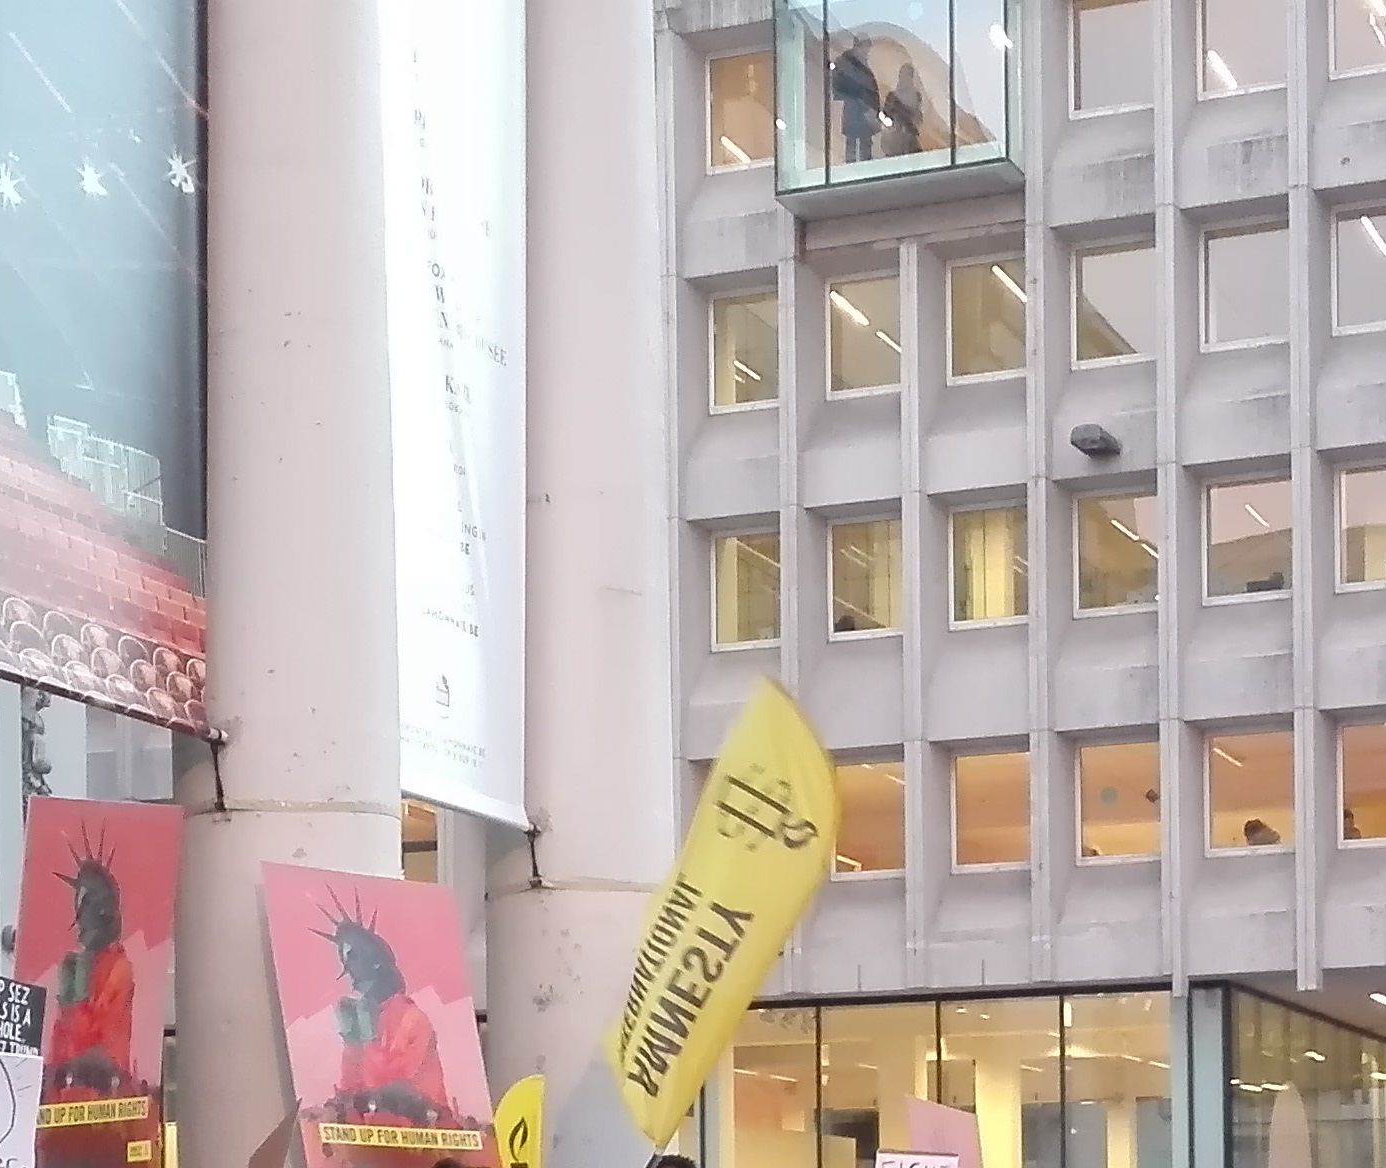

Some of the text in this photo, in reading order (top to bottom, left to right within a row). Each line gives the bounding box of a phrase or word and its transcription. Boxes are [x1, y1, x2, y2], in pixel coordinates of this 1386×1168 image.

[8, 982, 30, 1005] SEZ
[11, 1003, 21, 1023] IS
[22, 1008, 31, 1027] A
[68, 1105, 85, 1122] FOR
[87, 1102, 116, 1120] HUMAN
[118, 1099, 146, 1118] RIGHTS
[323, 1126, 479, 1147] STAND UP FOR HUMAN RIGHTS
